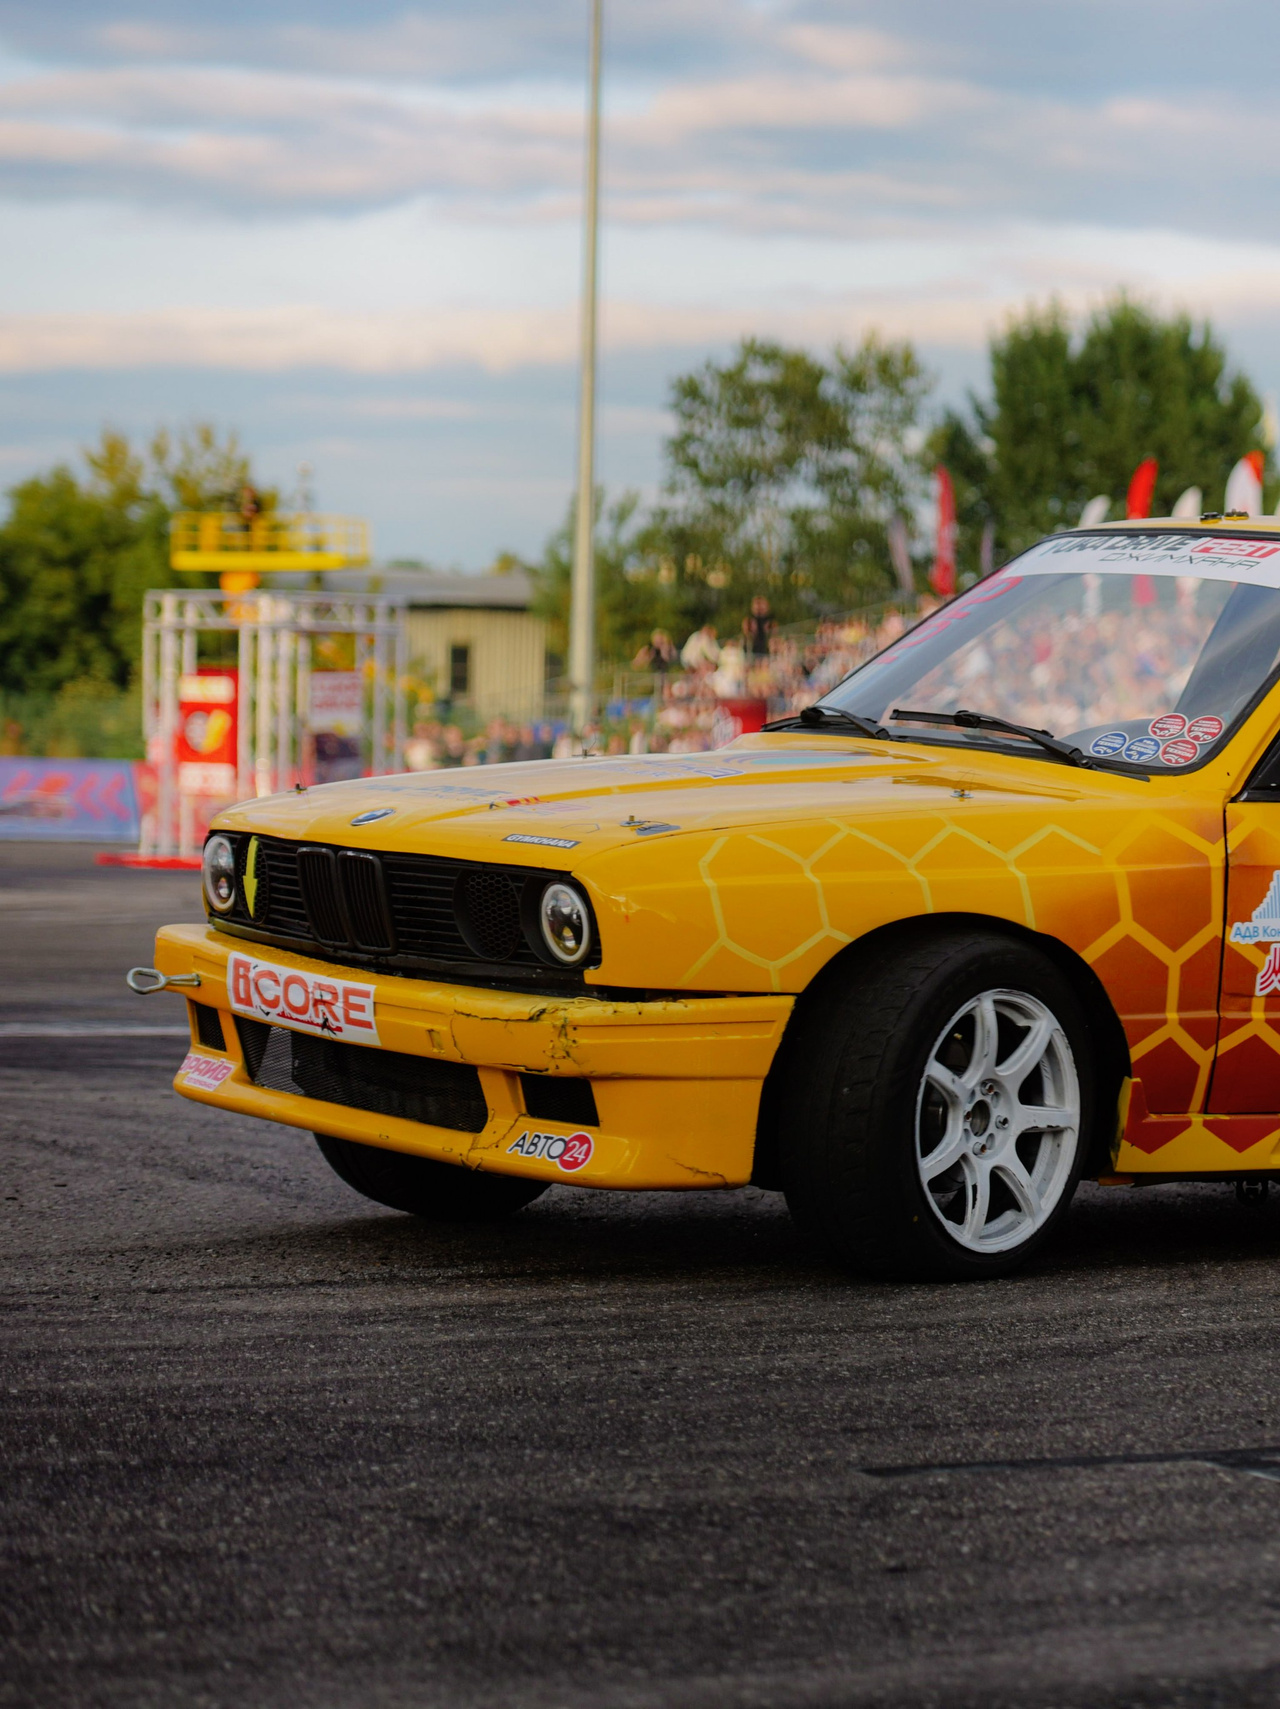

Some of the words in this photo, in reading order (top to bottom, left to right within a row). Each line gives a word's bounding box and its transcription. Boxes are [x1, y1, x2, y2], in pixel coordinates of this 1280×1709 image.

[1199, 539, 1280, 558] FEST
[506, 834, 578, 849] GYMKHANA
[1233, 926, 1260, 939] АДВ
